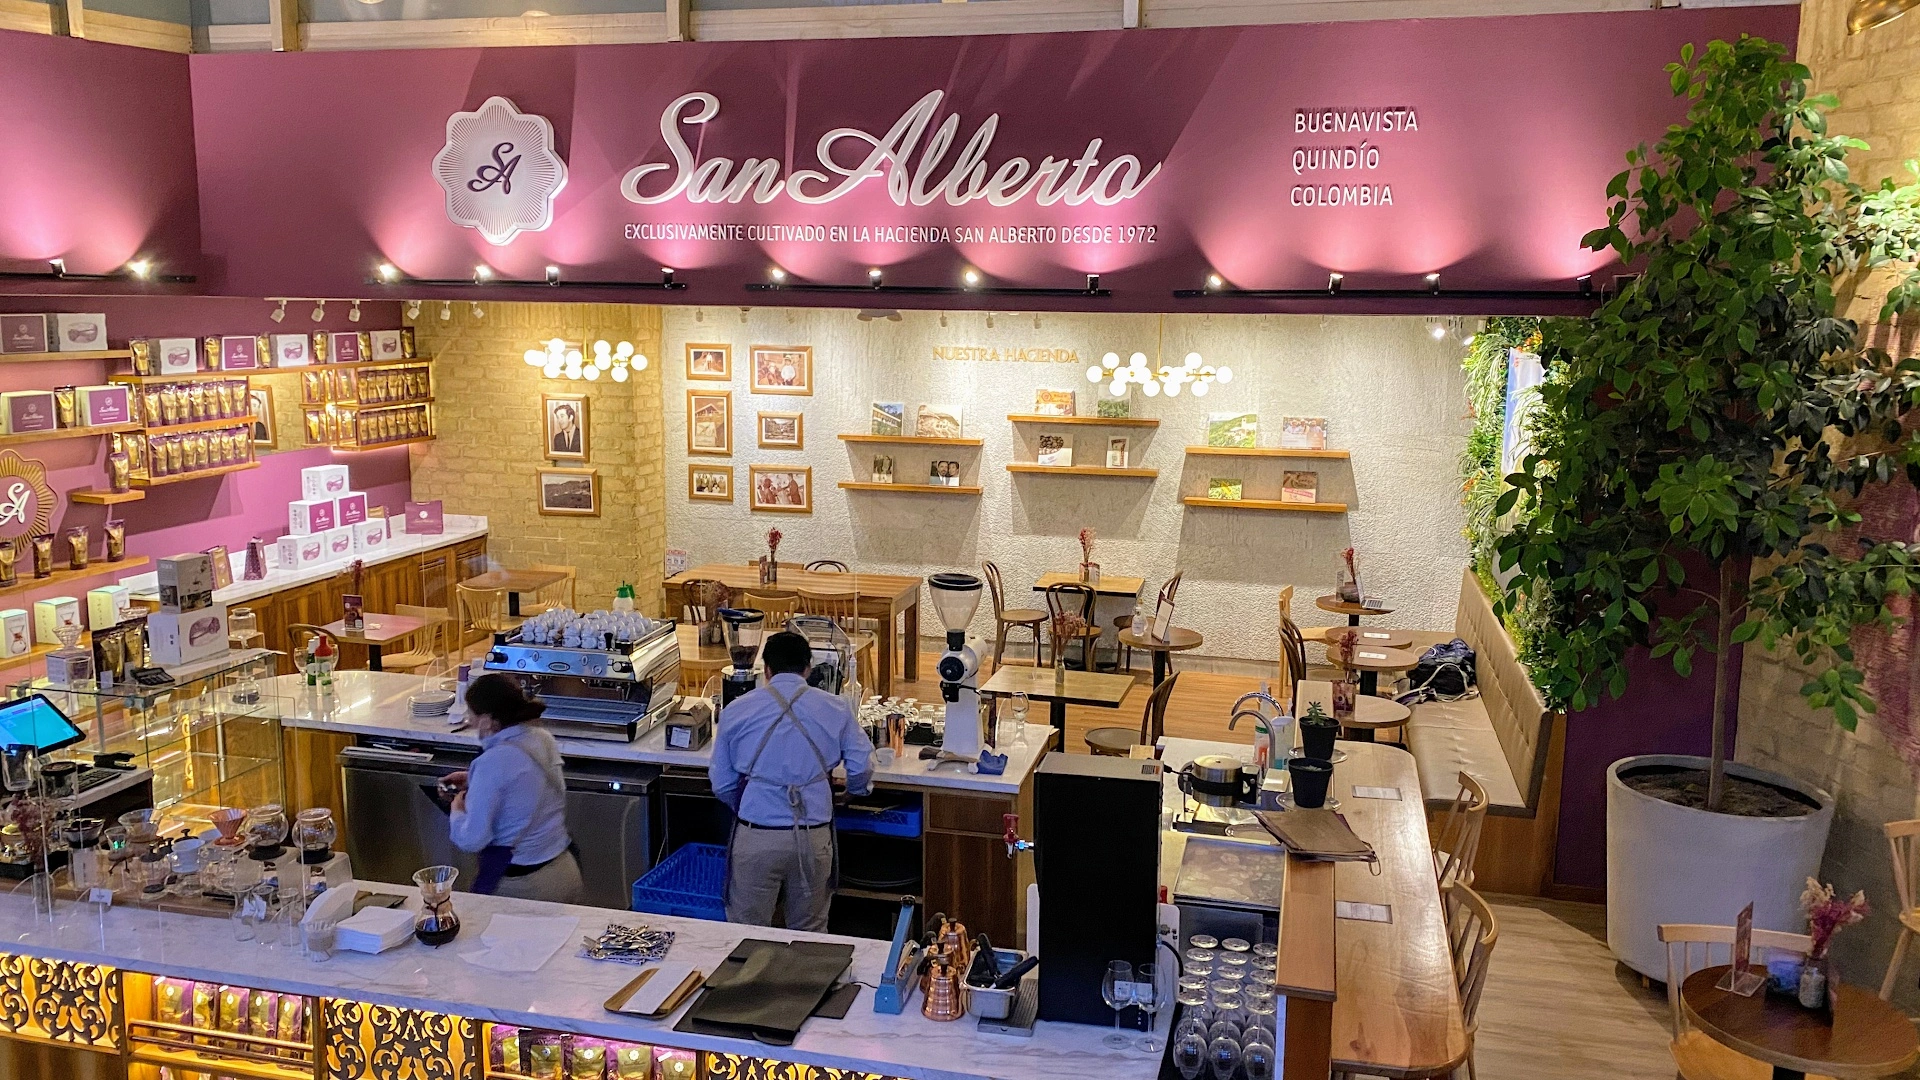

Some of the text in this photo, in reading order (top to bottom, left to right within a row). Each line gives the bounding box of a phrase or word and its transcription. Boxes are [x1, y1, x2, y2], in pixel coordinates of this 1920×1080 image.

[1294, 110, 1419, 133] BUENAVISTA
[620, 89, 1162, 207] San Alberto
[1292, 141, 1380, 176] QUINDÍO
[1290, 185, 1394, 207] COLOMBIA
[624, 223, 1157, 244] EXCLUSIVAMENTE CULTIVADO EN LA HACIENDA SAN ALBERTO DESDE 1972
[932, 346, 1000, 362] NUESTRA
